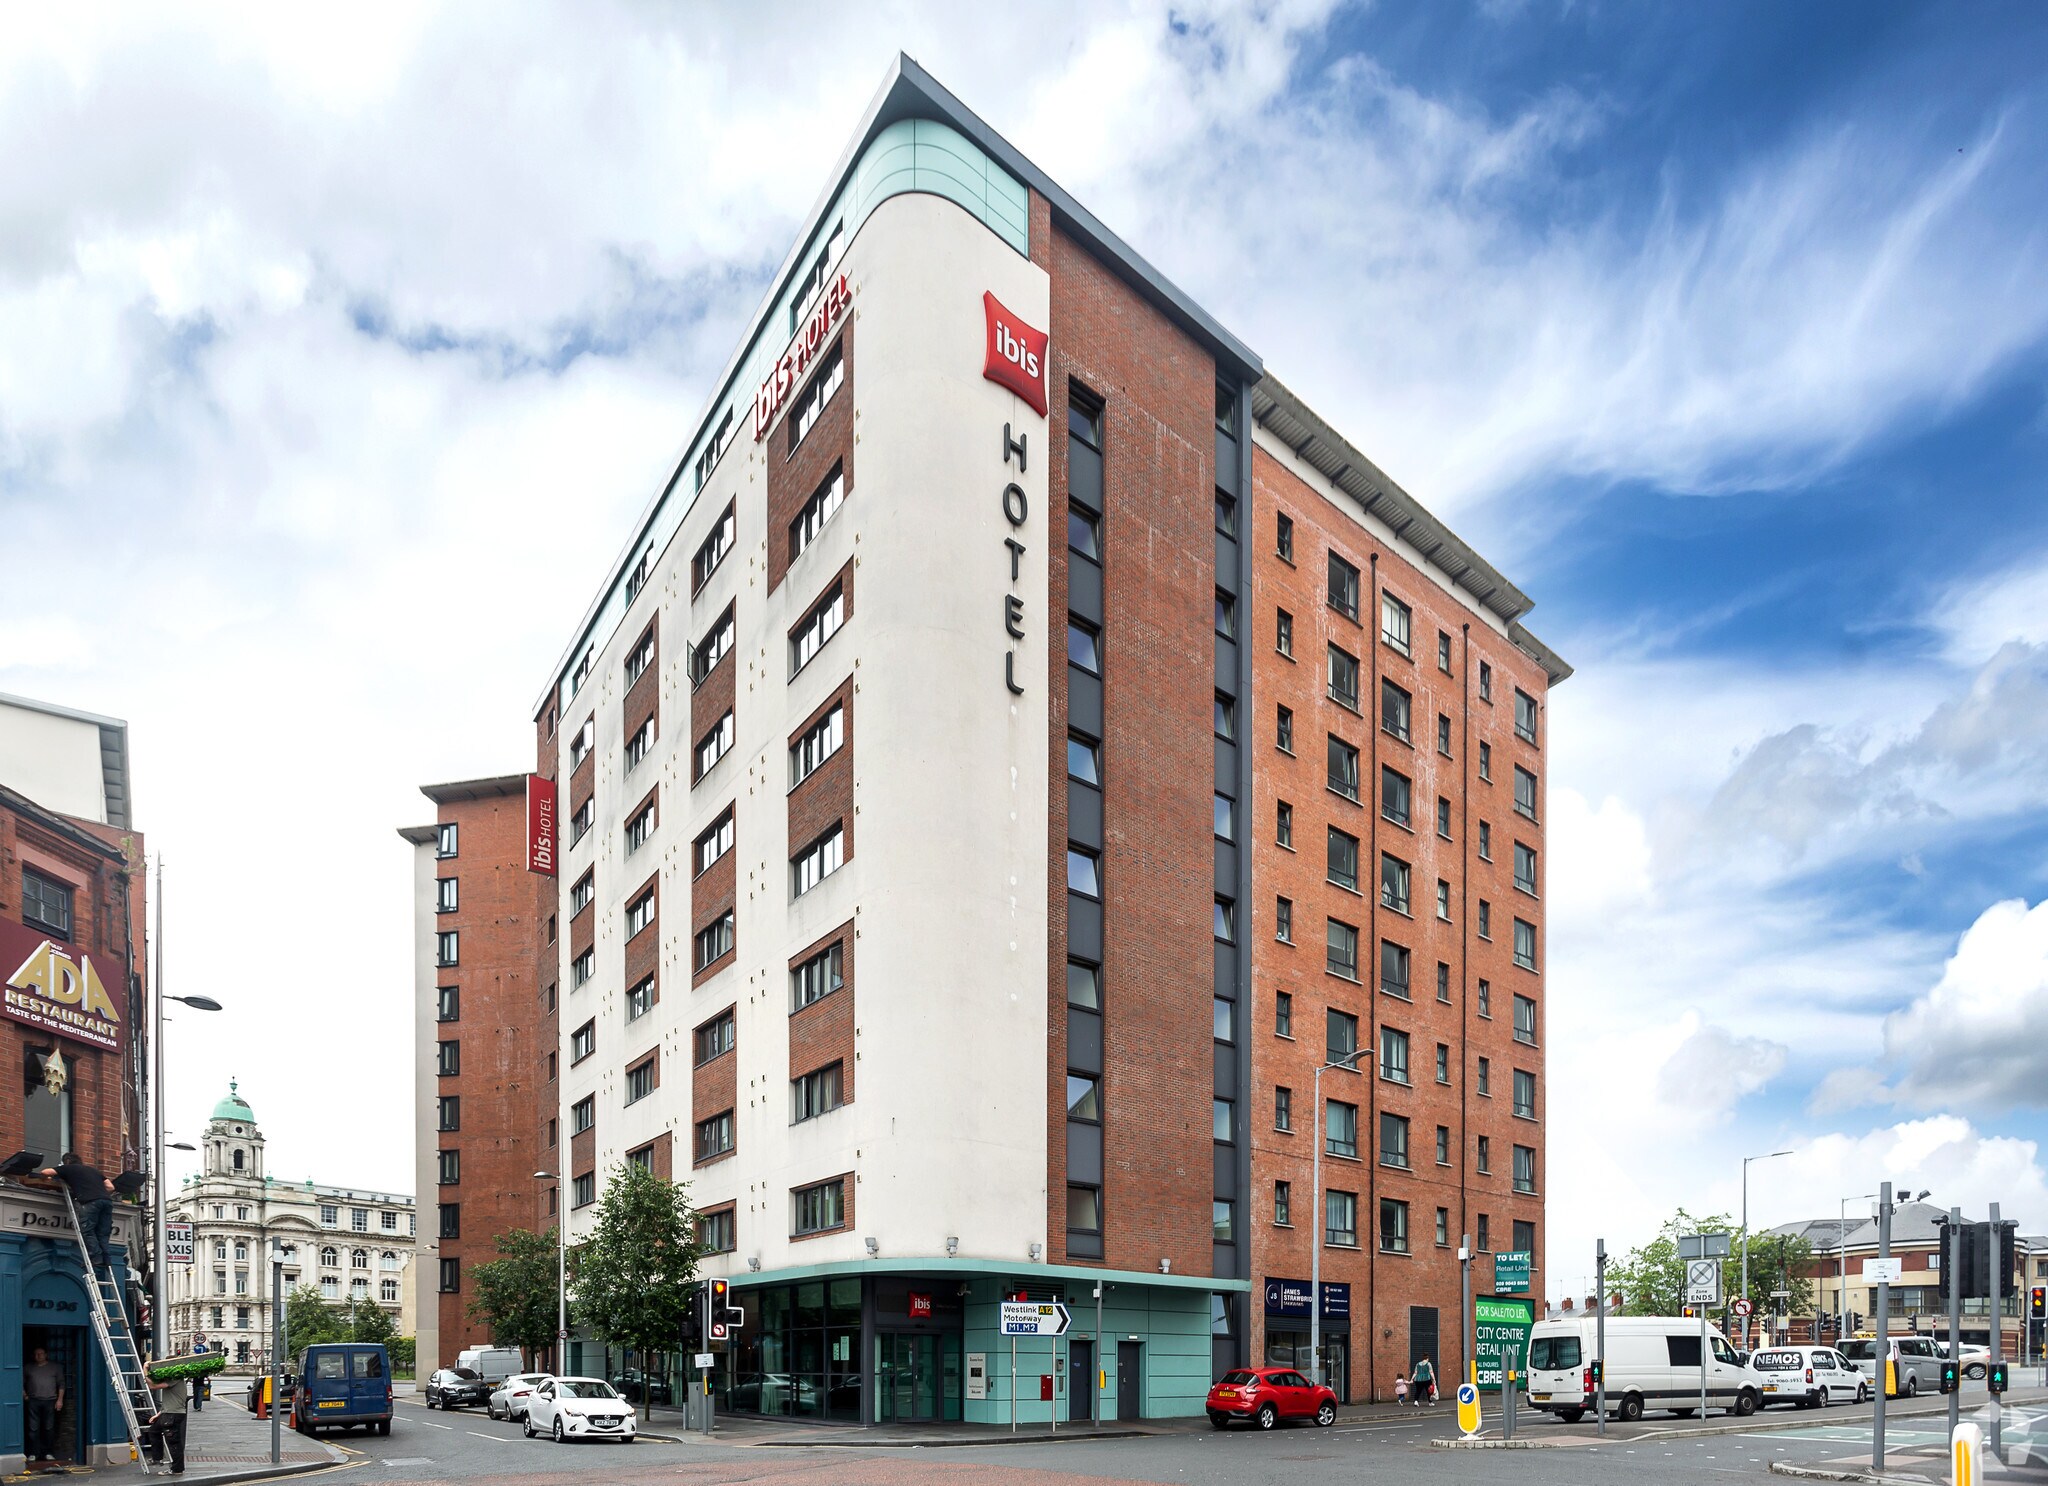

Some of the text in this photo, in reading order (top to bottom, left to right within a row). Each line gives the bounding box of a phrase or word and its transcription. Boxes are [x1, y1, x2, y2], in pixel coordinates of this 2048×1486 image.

[795, 273, 852, 374] HOTEL
[996, 320, 1039, 378] ibis
[1003, 421, 1028, 696] HOTEL
[533, 797, 551, 869] ibis HOTEL
[6, 940, 121, 1022] ADA
[5, 989, 119, 1038] RESTAURANT
[5, 1005, 117, 1048] TASTE OF THE MEDITERRANEAN
[168, 1231, 191, 1242] BLE
[166, 1245, 192, 1255] AXIS
[1497, 1254, 1507, 1262] TO
[914, 1298, 930, 1309] ibis
[1039, 1306, 1053, 1314] A12
[1004, 1315, 1041, 1323] Motorway
[1476, 1306, 1526, 1319] FOR SALE/TO LET
[1476, 1327, 1524, 1340] CITY CENTRE
[1477, 1343, 1520, 1356] RETAIL UNIT
[1756, 1354, 1800, 1365] NEMOS
[1477, 1370, 1502, 1384] CBRE
